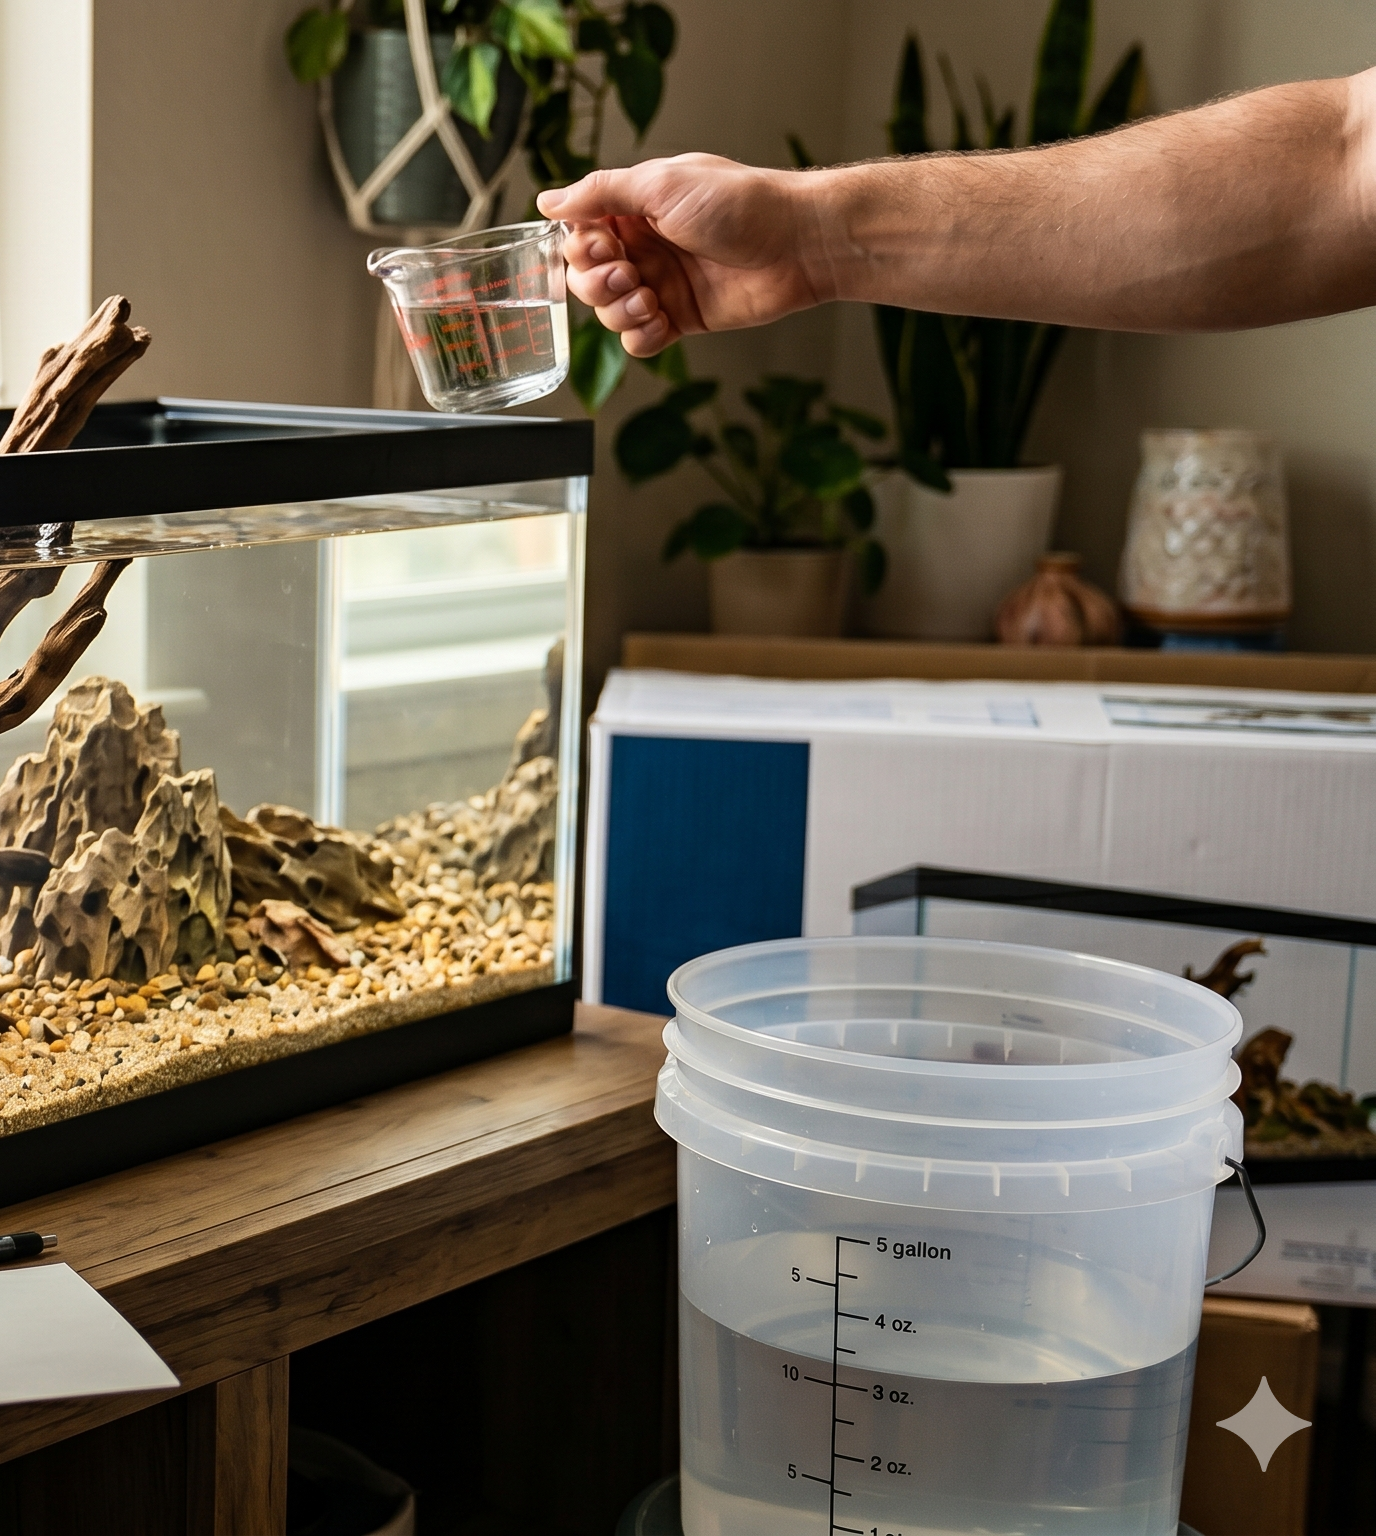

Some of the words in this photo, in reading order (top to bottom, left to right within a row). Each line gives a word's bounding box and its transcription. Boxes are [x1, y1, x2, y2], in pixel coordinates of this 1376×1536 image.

[876, 1236, 888, 1253] 5
[892, 1241, 951, 1261] gallon
[791, 1266, 801, 1283] 5
[874, 1313, 886, 1330] 4
[891, 1318, 917, 1334] oz.
[781, 1363, 799, 1382] 10
[872, 1384, 884, 1401] 3
[889, 1390, 914, 1405] oz.
[787, 1463, 797, 1480] 5
[870, 1455, 882, 1472] 2
[886, 1461, 912, 1476] oz.
